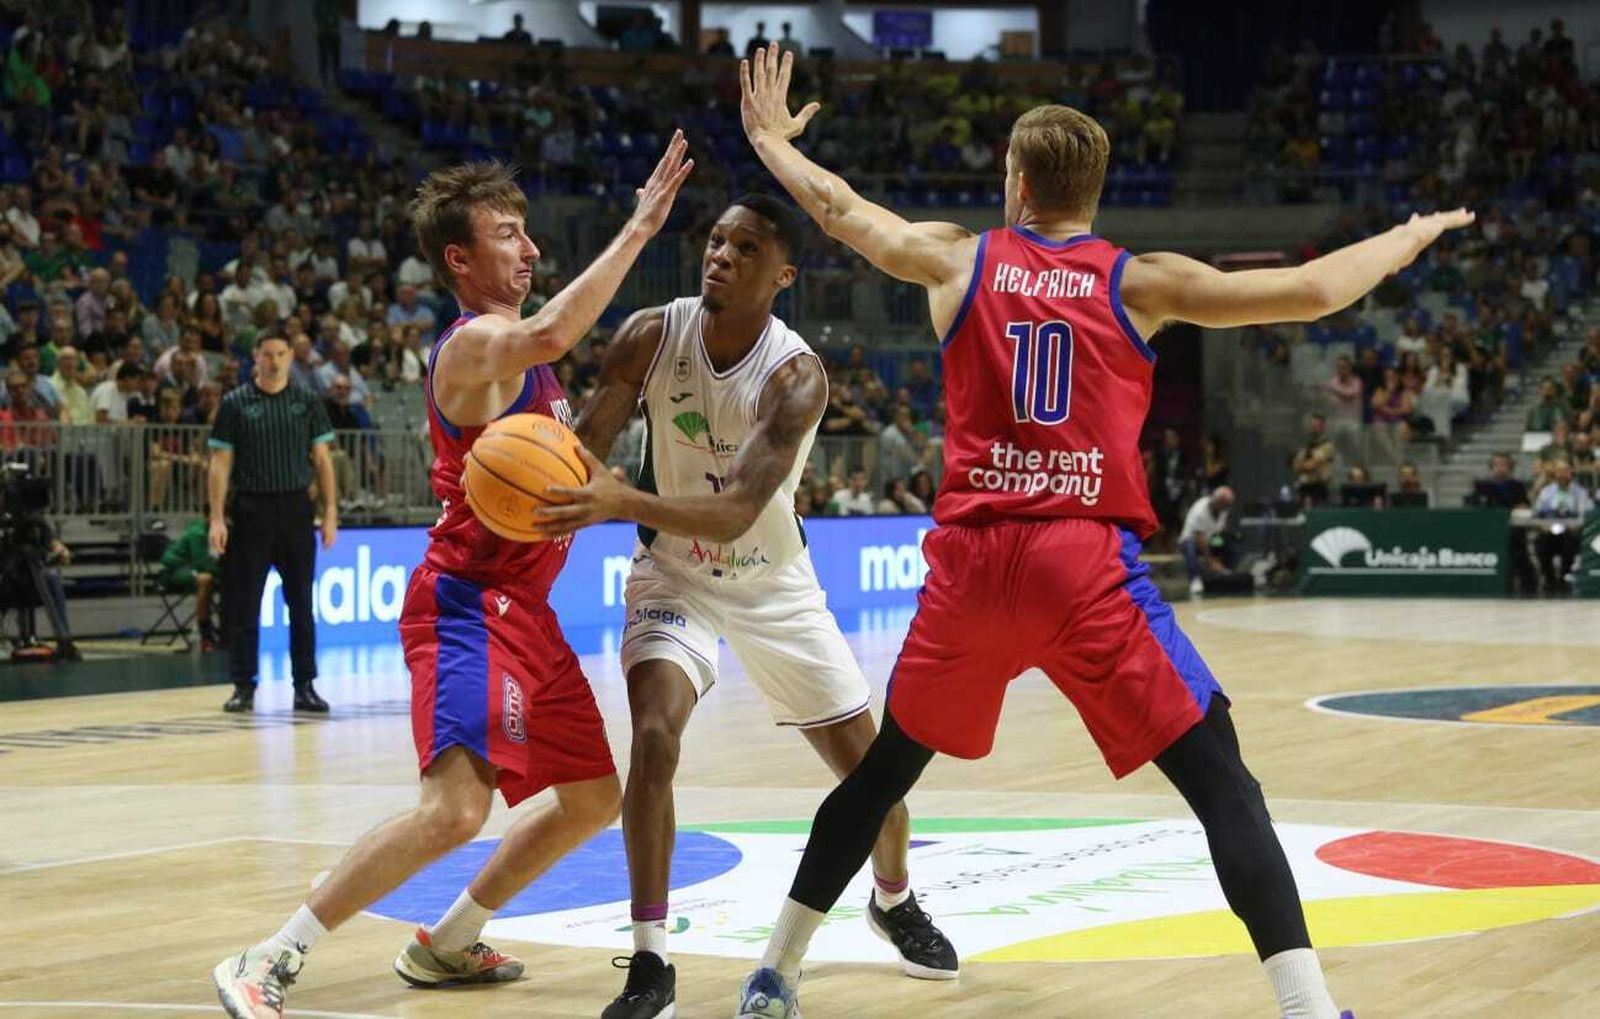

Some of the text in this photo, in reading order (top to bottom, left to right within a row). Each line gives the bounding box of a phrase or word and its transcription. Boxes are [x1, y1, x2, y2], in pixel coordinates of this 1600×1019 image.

[993, 262, 1096, 299] HELFRICH
[1005, 319, 1074, 426] 10
[990, 441, 1105, 475] the rent
[968, 466, 1103, 507] company
[1364, 546, 1499, 570] Unicaja Banco
